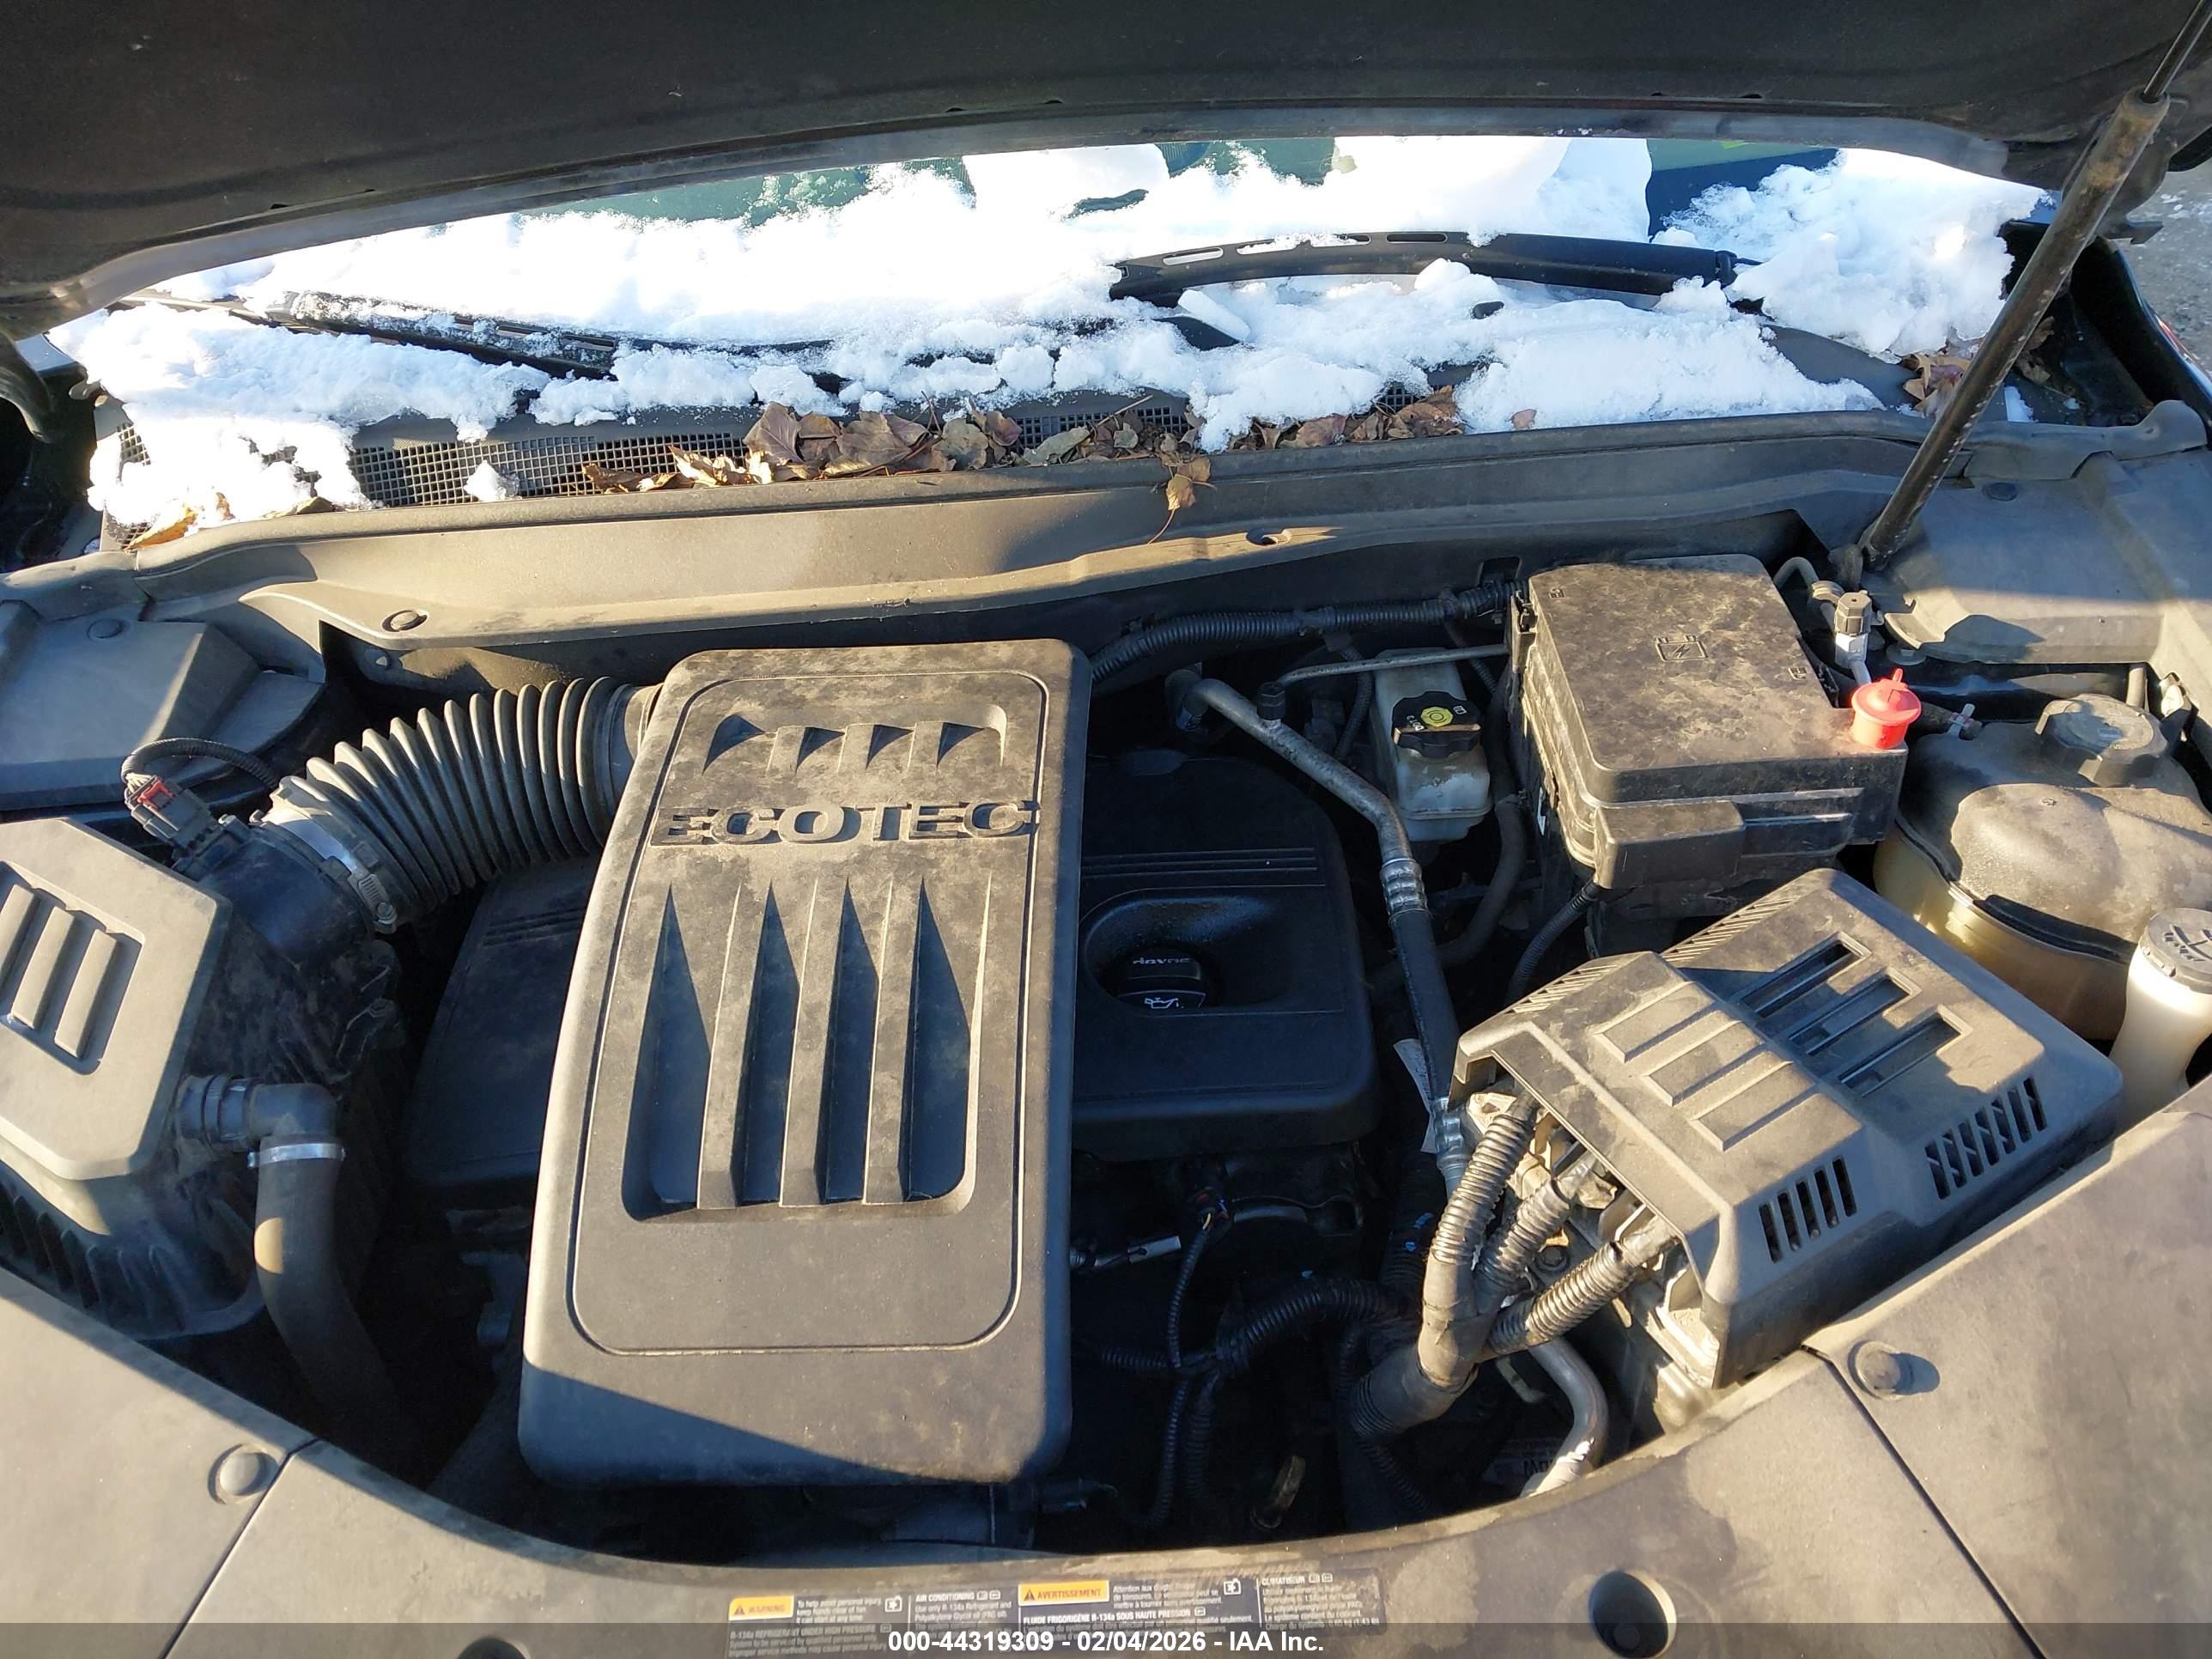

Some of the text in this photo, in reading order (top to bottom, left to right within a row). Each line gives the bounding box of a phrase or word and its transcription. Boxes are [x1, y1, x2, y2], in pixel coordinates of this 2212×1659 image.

[650, 800, 1041, 847] ECOTEC
[915, 1591, 975, 1602] AIR CONDITIONING
[1037, 1589, 1102, 1600] AVERTISSEMENT
[1023, 1615, 1047, 1626] FLUIDE
[1116, 1611, 1134, 1621] SOUS
[1135, 1610, 1158, 1620] HAUTE
